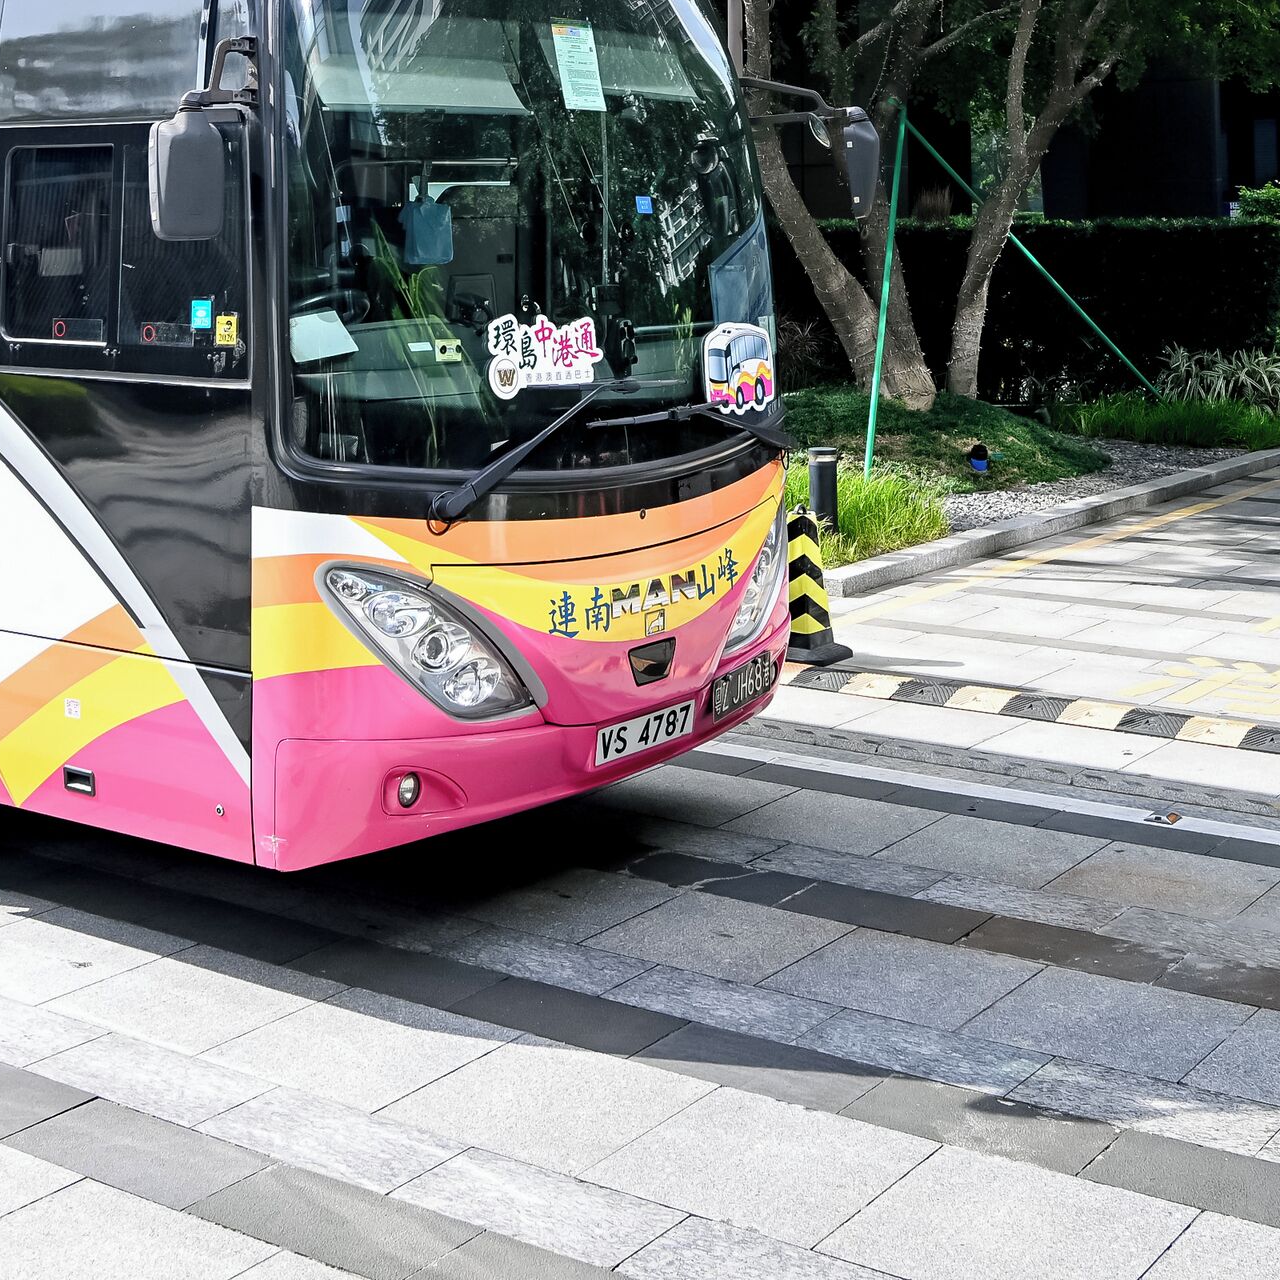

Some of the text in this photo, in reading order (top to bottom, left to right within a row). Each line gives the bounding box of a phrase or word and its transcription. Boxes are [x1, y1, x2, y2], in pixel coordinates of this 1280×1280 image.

[218, 333, 235, 342] 2026
[493, 319, 600, 370] 環島中港通
[610, 569, 698, 619] MAN
[696, 547, 738, 601] 山峰
[549, 586, 611, 639] 連南
[601, 703, 693, 761] VS 4787
